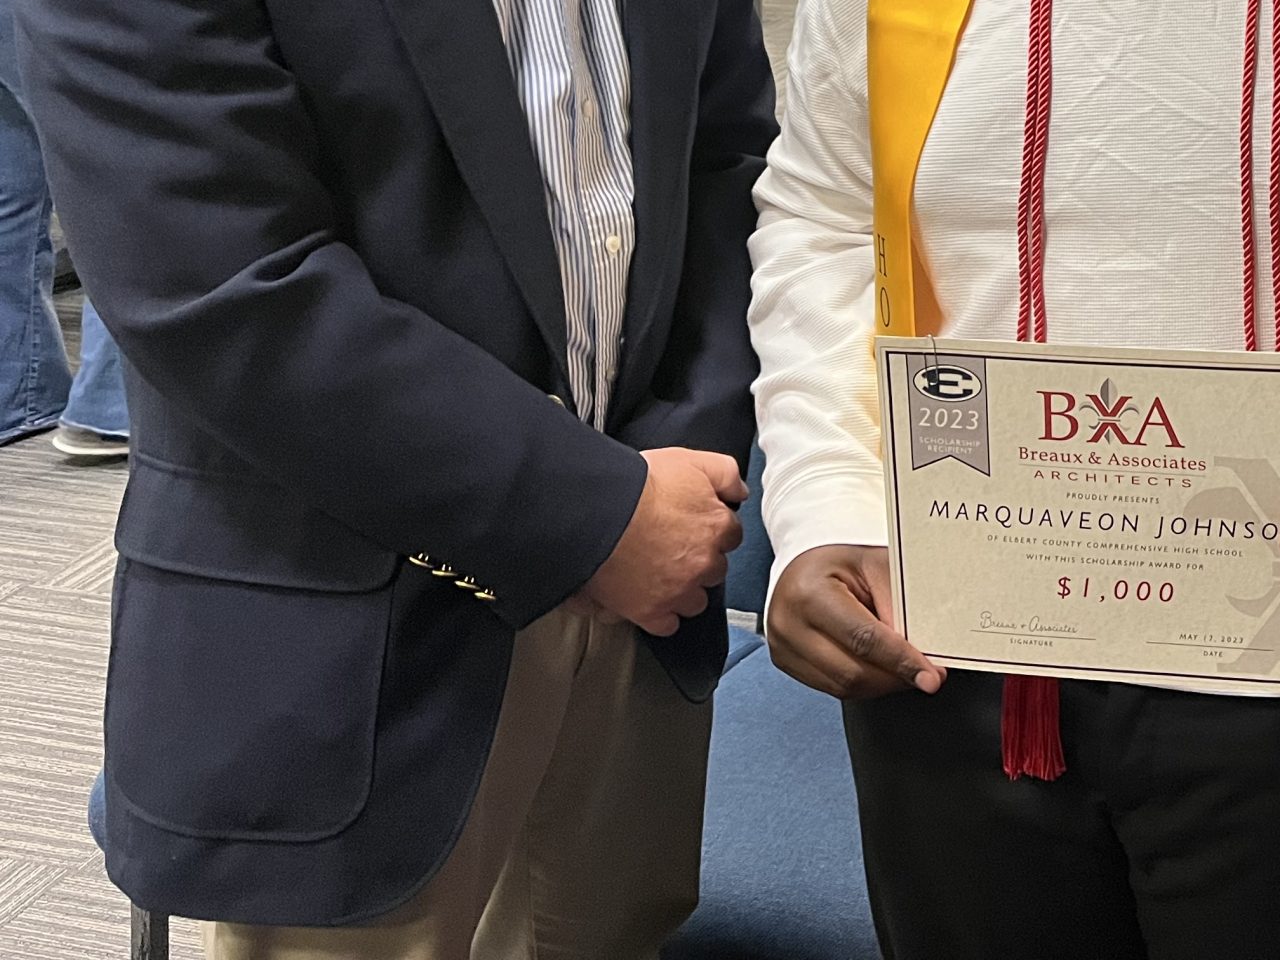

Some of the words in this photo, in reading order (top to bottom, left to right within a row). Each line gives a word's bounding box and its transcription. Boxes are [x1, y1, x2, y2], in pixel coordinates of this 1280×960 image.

[918, 407, 979, 430] 2023
[919, 436, 980, 447] SCHOLARSHIP
[927, 444, 973, 455] RECIPIENT
[1018, 446, 1083, 464] Breaux
[1088, 451, 1101, 465] &
[1108, 452, 1207, 471] Associates
[1034, 470, 1192, 489] ARCHITECTS
[1066, 492, 1108, 502] PROUDLY
[1112, 495, 1160, 505] PRESENTS
[929, 500, 1139, 533] MARQUAVEON
[987, 534, 998, 542] OF
[1003, 535, 1037, 545] ELBERT
[1042, 538, 1082, 548] COUNTY
[1086, 541, 1168, 553] COMPREHENSIVE
[1173, 546, 1199, 554] HIGH
[1204, 547, 1243, 557] SCHOOL
[1026, 553, 1051, 561] WITH
[1054, 555, 1075, 563] THIS
[1081, 557, 1145, 567] SCHOLARSHIP
[1149, 561, 1181, 570] AWARD
[1057, 576, 1174, 603] $1,000
[1010, 638, 1053, 647] SIGNATURE
[1179, 633, 1198, 641] MAY
[1220, 635, 1244, 644] 2023
[1203, 650, 1223, 658] DATE
